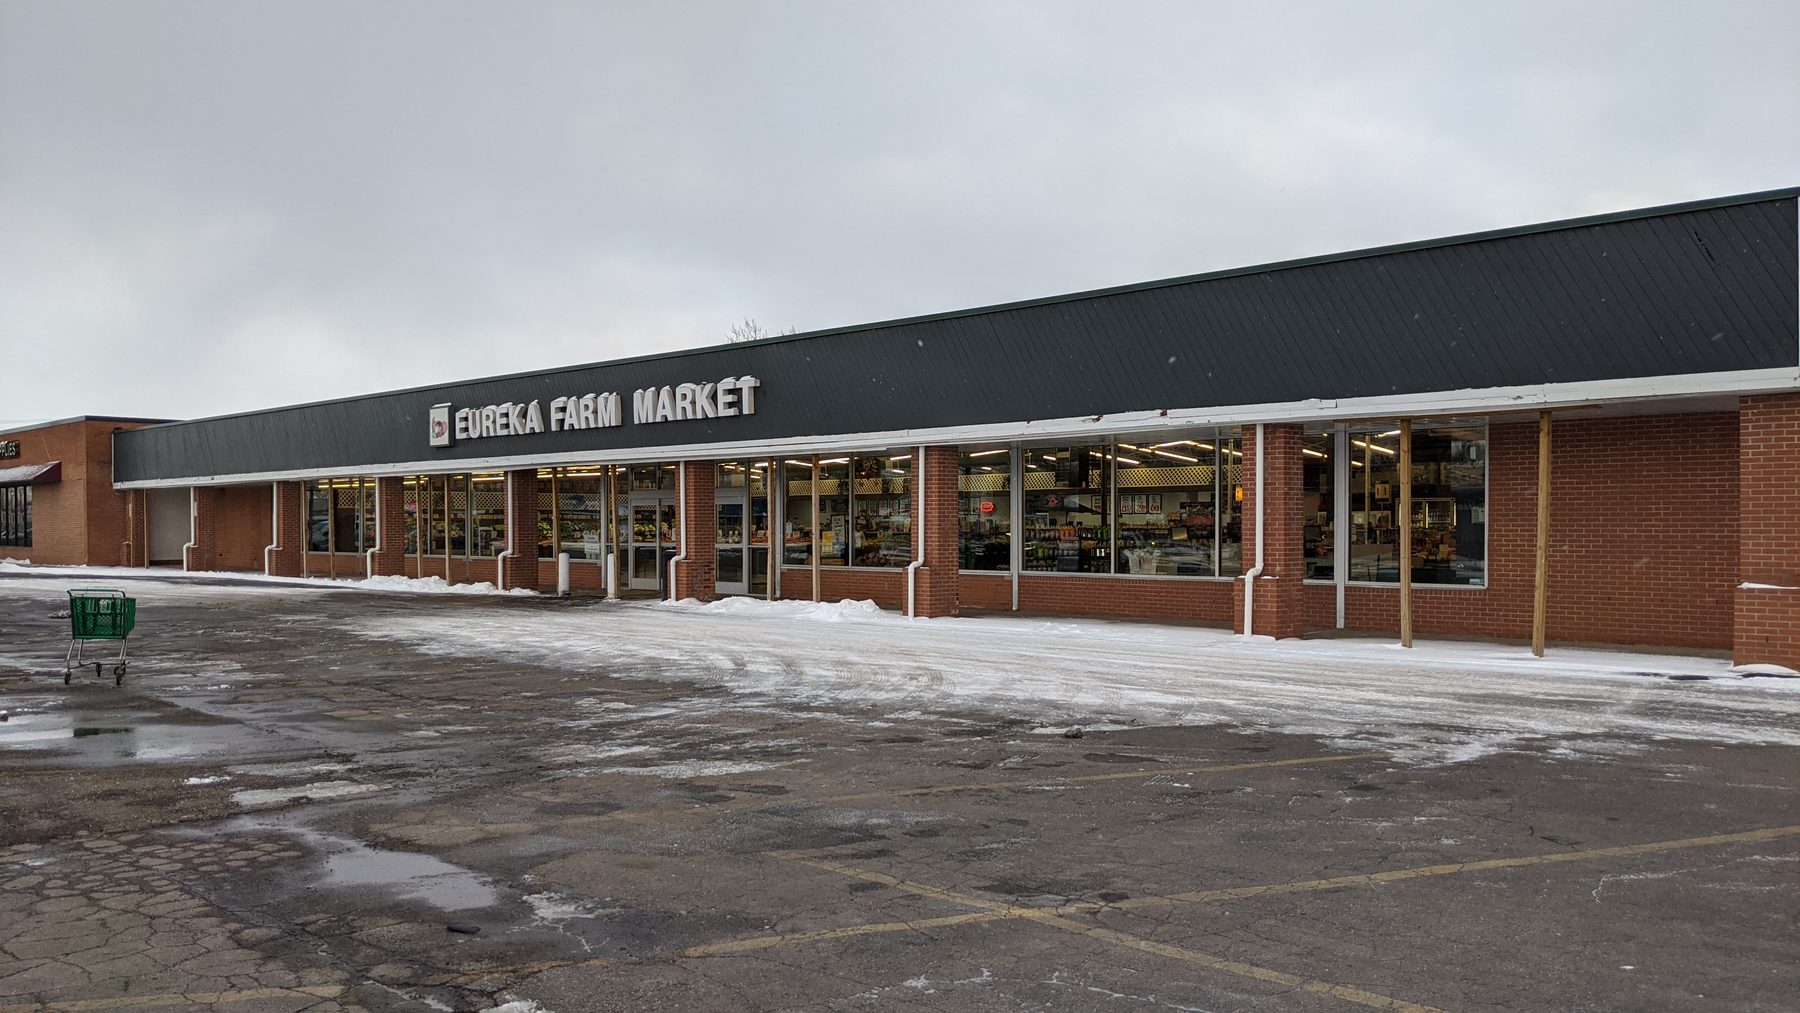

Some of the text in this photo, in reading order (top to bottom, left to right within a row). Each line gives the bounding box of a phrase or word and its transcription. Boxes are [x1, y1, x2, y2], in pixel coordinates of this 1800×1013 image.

[455, 377, 760, 440] EUREKA FARM MARKET
